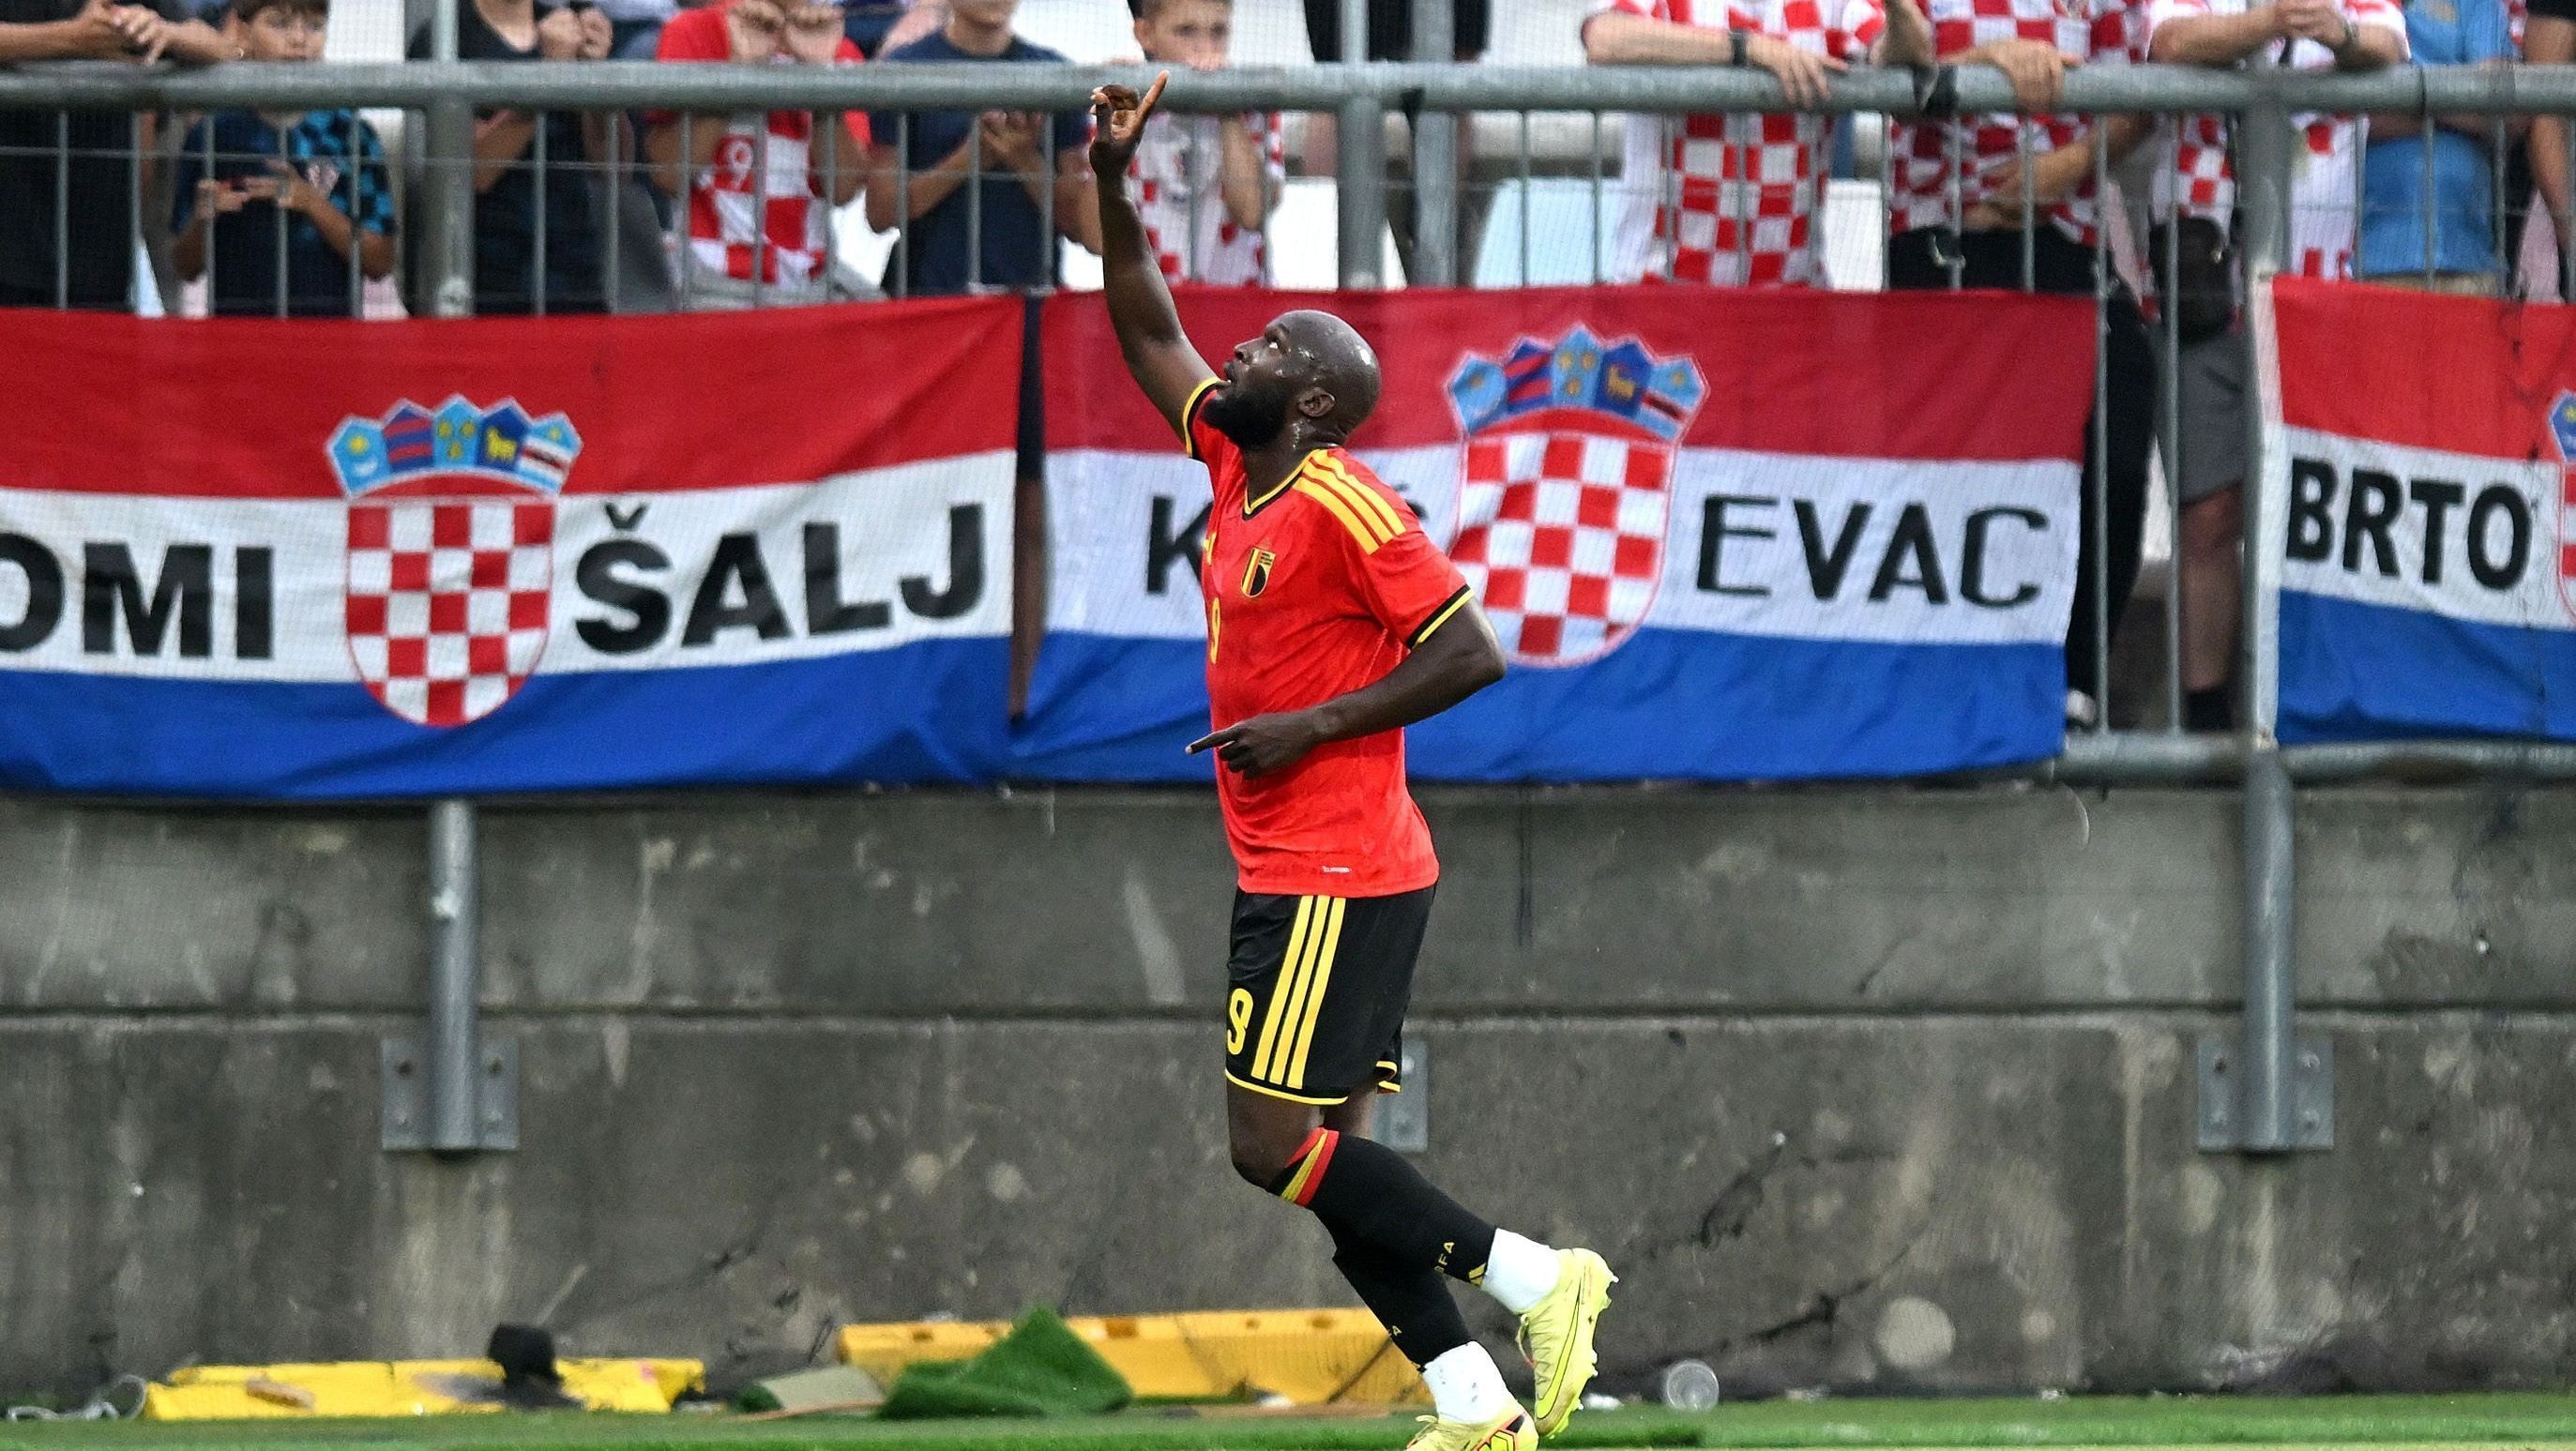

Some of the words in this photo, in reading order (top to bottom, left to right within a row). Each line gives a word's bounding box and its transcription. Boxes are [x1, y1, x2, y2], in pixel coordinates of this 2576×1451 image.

[575, 503, 986, 655] ŠALJ
[1697, 492, 2049, 610] EVAC
[2286, 456, 2534, 592] BRTO
[1227, 988, 1254, 1055] 9
